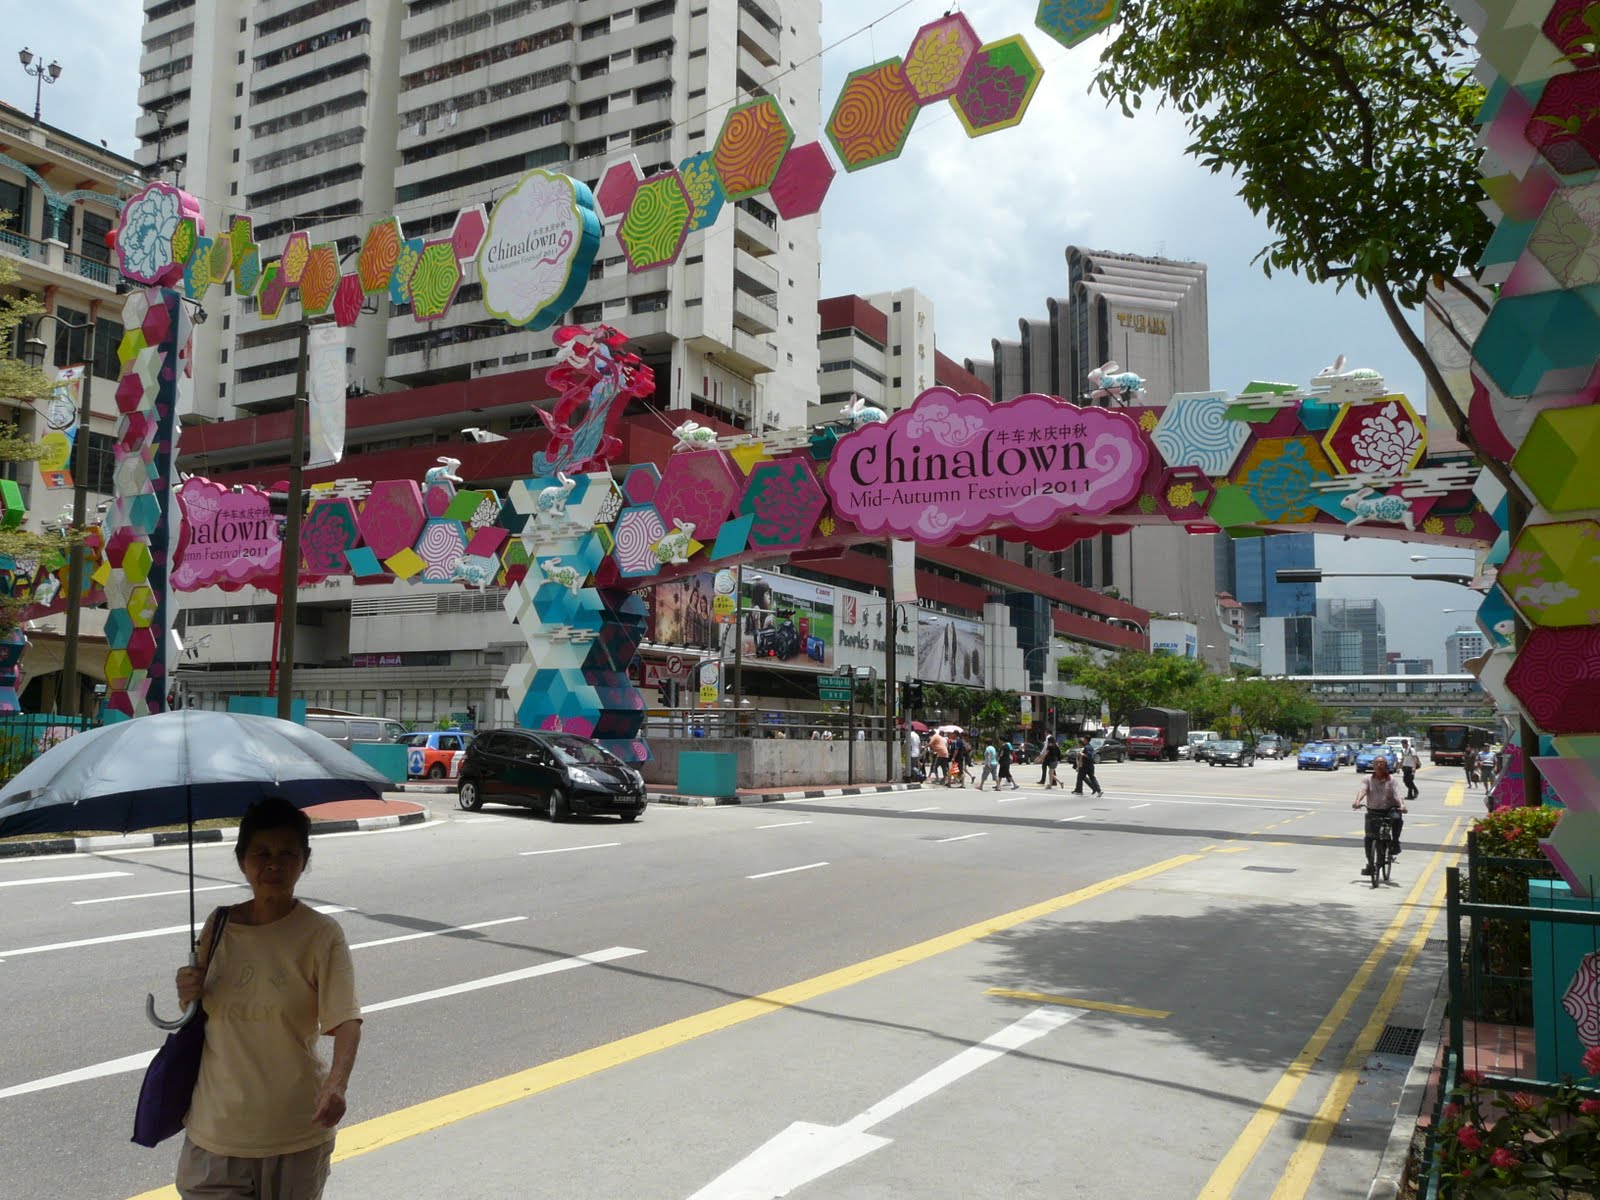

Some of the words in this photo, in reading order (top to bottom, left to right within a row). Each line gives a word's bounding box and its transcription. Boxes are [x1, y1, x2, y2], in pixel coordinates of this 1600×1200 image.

[488, 231, 556, 263] Chinatown
[543, 248, 558, 257] 2011
[997, 423, 1088, 446] 牛车水庆中秋
[850, 429, 1089, 487] Chinatown
[851, 488, 961, 508] Mid-Autumn
[968, 478, 1037, 501] Festival
[1041, 479, 1091, 495] 2011
[205, 545, 241, 560] Festival
[243, 547, 268, 558] 2011
[816, 587, 831, 596] Canon
[873, 639, 886, 653] PAR
